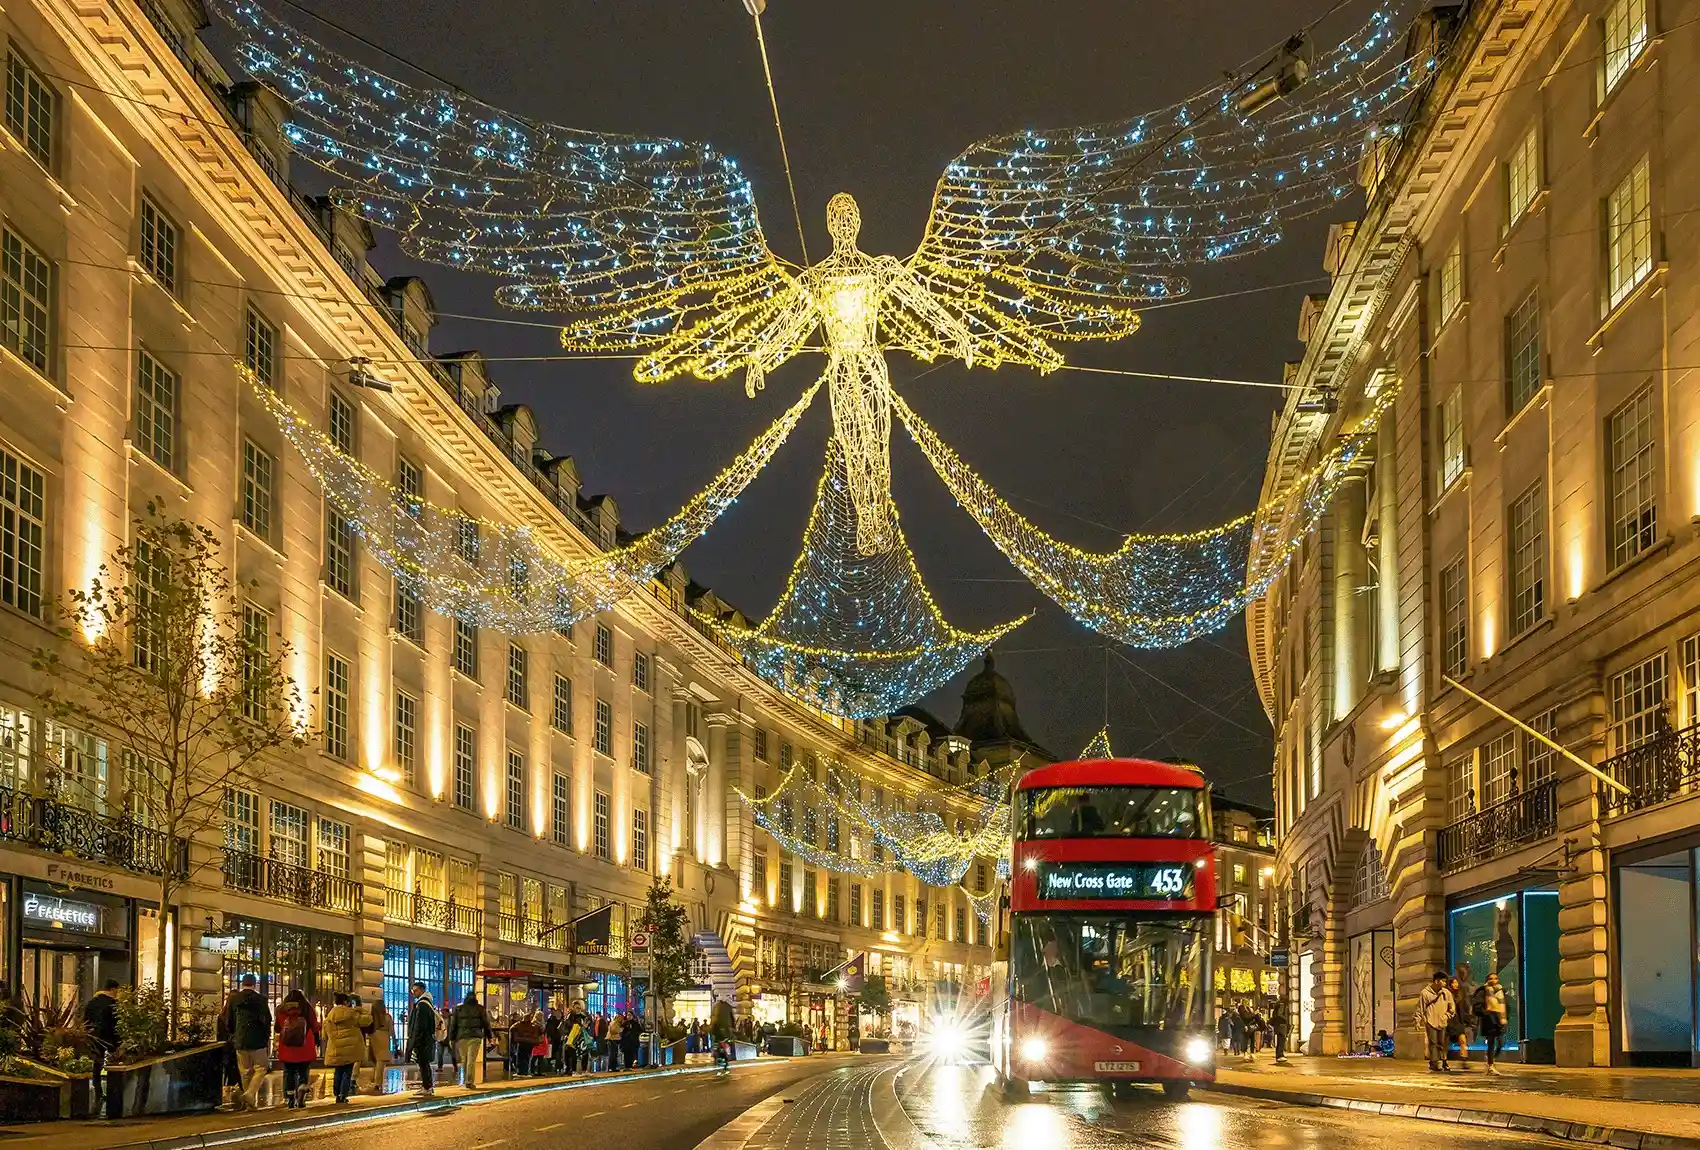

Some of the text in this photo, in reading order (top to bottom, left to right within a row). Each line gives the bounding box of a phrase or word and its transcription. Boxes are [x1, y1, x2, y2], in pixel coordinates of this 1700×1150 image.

[60, 870, 114, 889] FABLETICS
[1049, 872, 1133, 889] New Cross Gate
[1151, 868, 1183, 892] 453
[38, 905, 96, 926] FABLETICS
